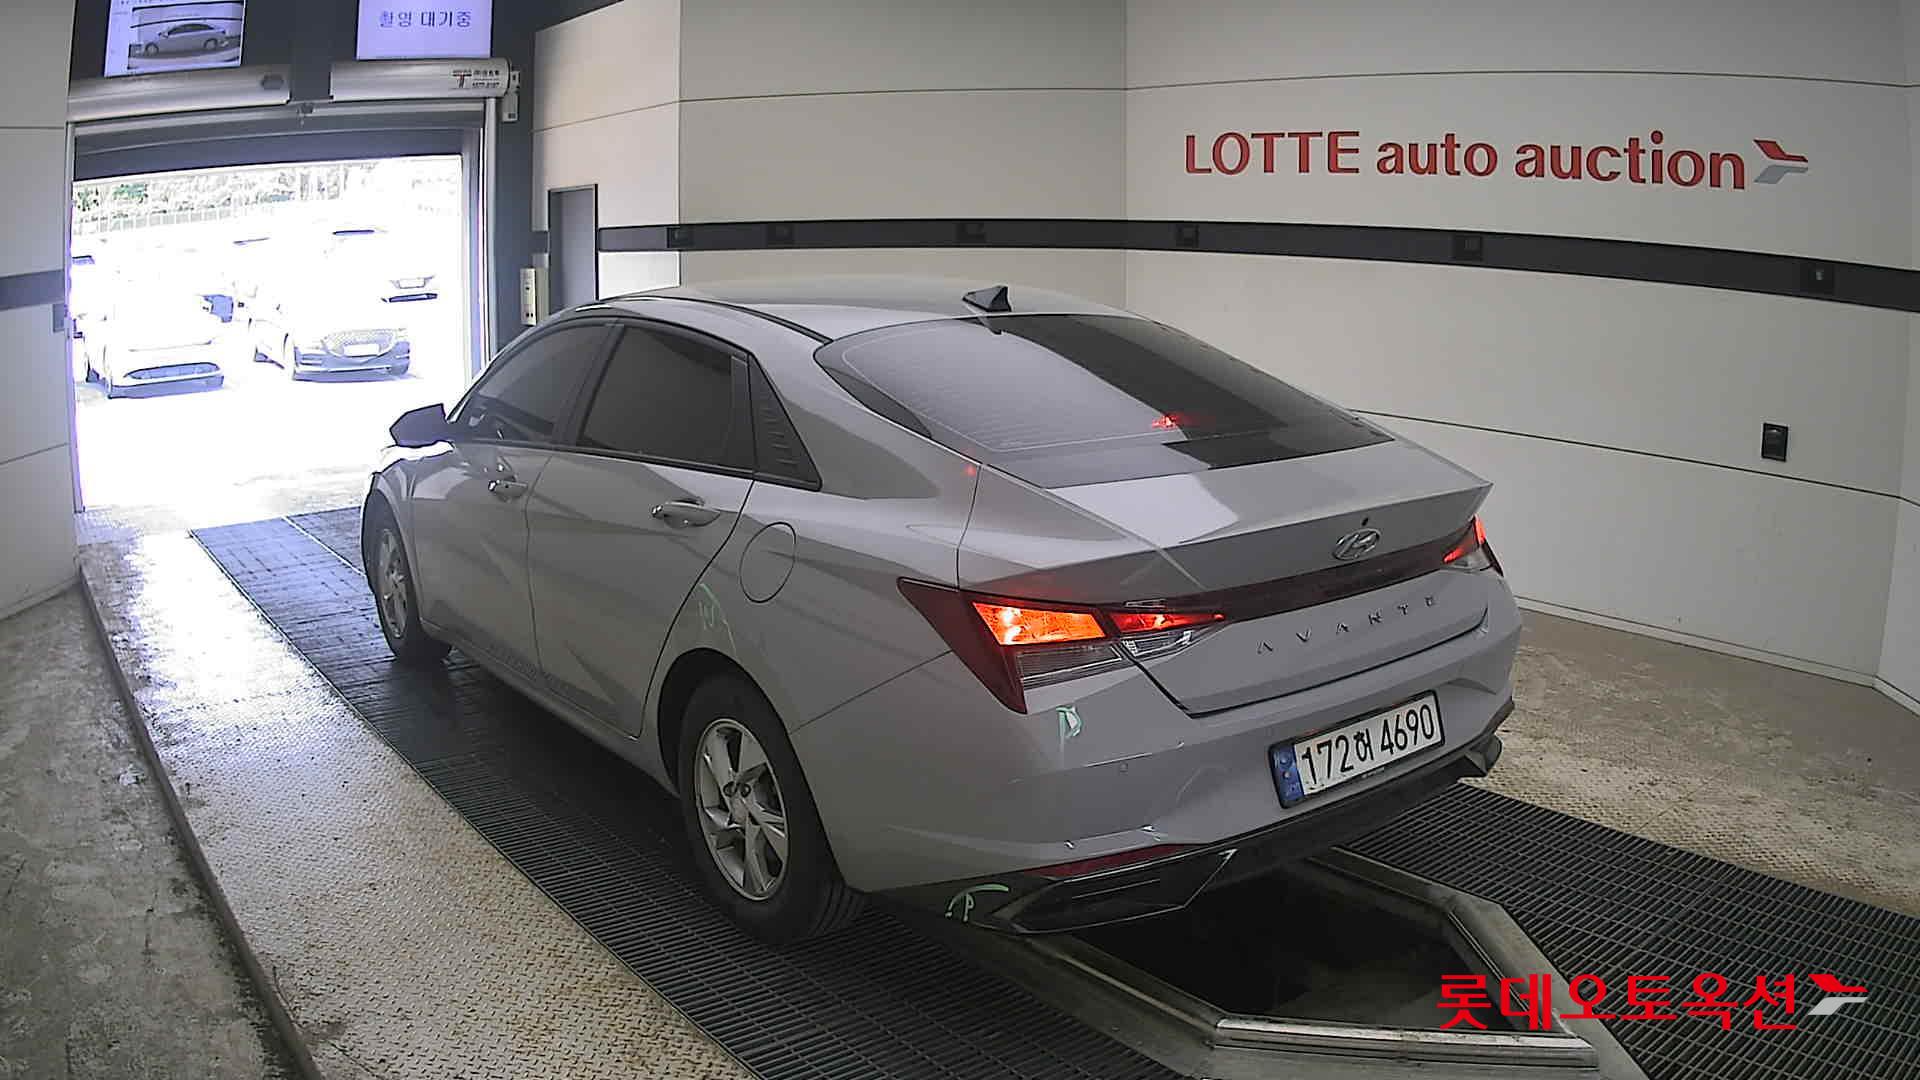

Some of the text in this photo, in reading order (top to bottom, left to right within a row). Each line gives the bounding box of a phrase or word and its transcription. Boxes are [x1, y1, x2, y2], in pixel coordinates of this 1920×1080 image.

[421, 11, 471, 27] 대기중
[1185, 130, 1746, 190] LOTTE auto auction
[1256, 595, 1435, 656] AVANTE
[1302, 704, 1435, 785] 172허 4690
